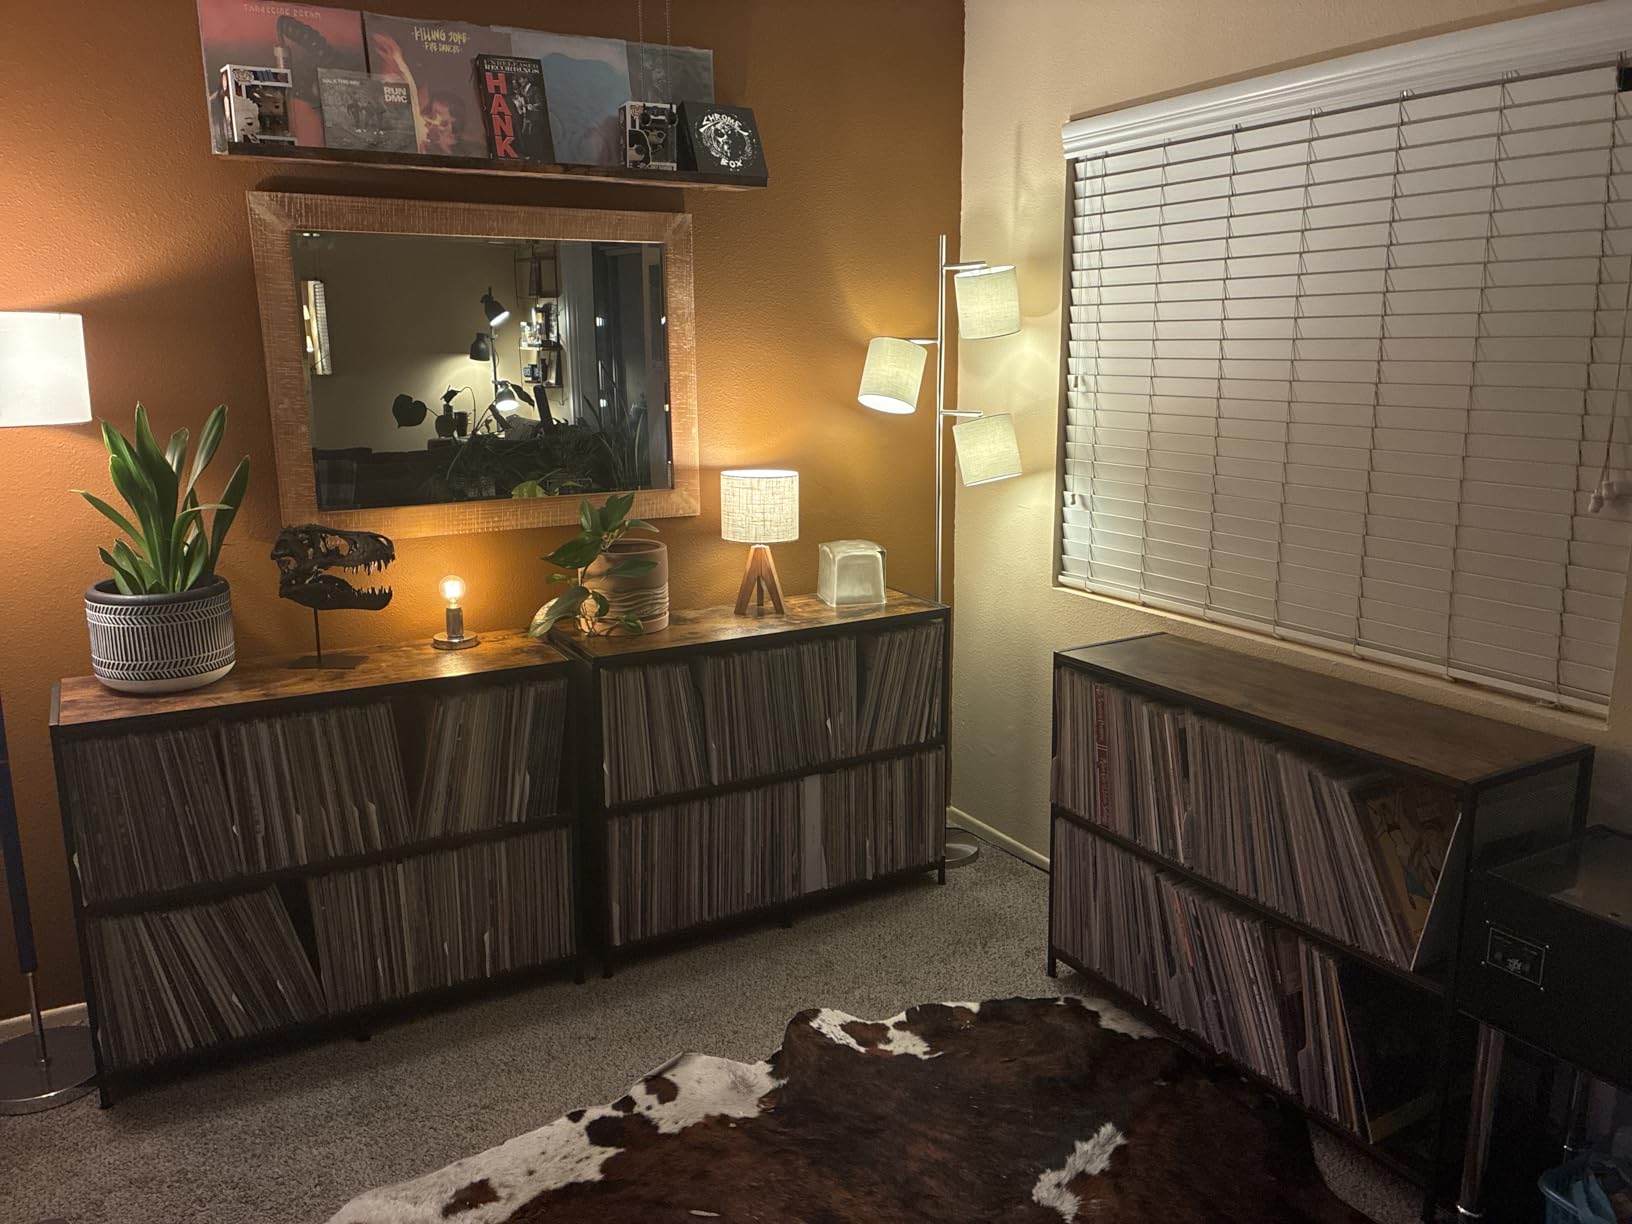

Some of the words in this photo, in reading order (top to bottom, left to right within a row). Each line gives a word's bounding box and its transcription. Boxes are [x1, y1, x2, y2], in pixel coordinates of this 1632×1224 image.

[414, 26, 446, 41] KILLING
[448, 31, 467, 44] JOKE
[384, 86, 406, 95] RUN
[385, 94, 408, 103] DMC
[485, 72, 519, 159] HANK
[702, 113, 742, 129] CHROME
[720, 158, 743, 168] BOX
